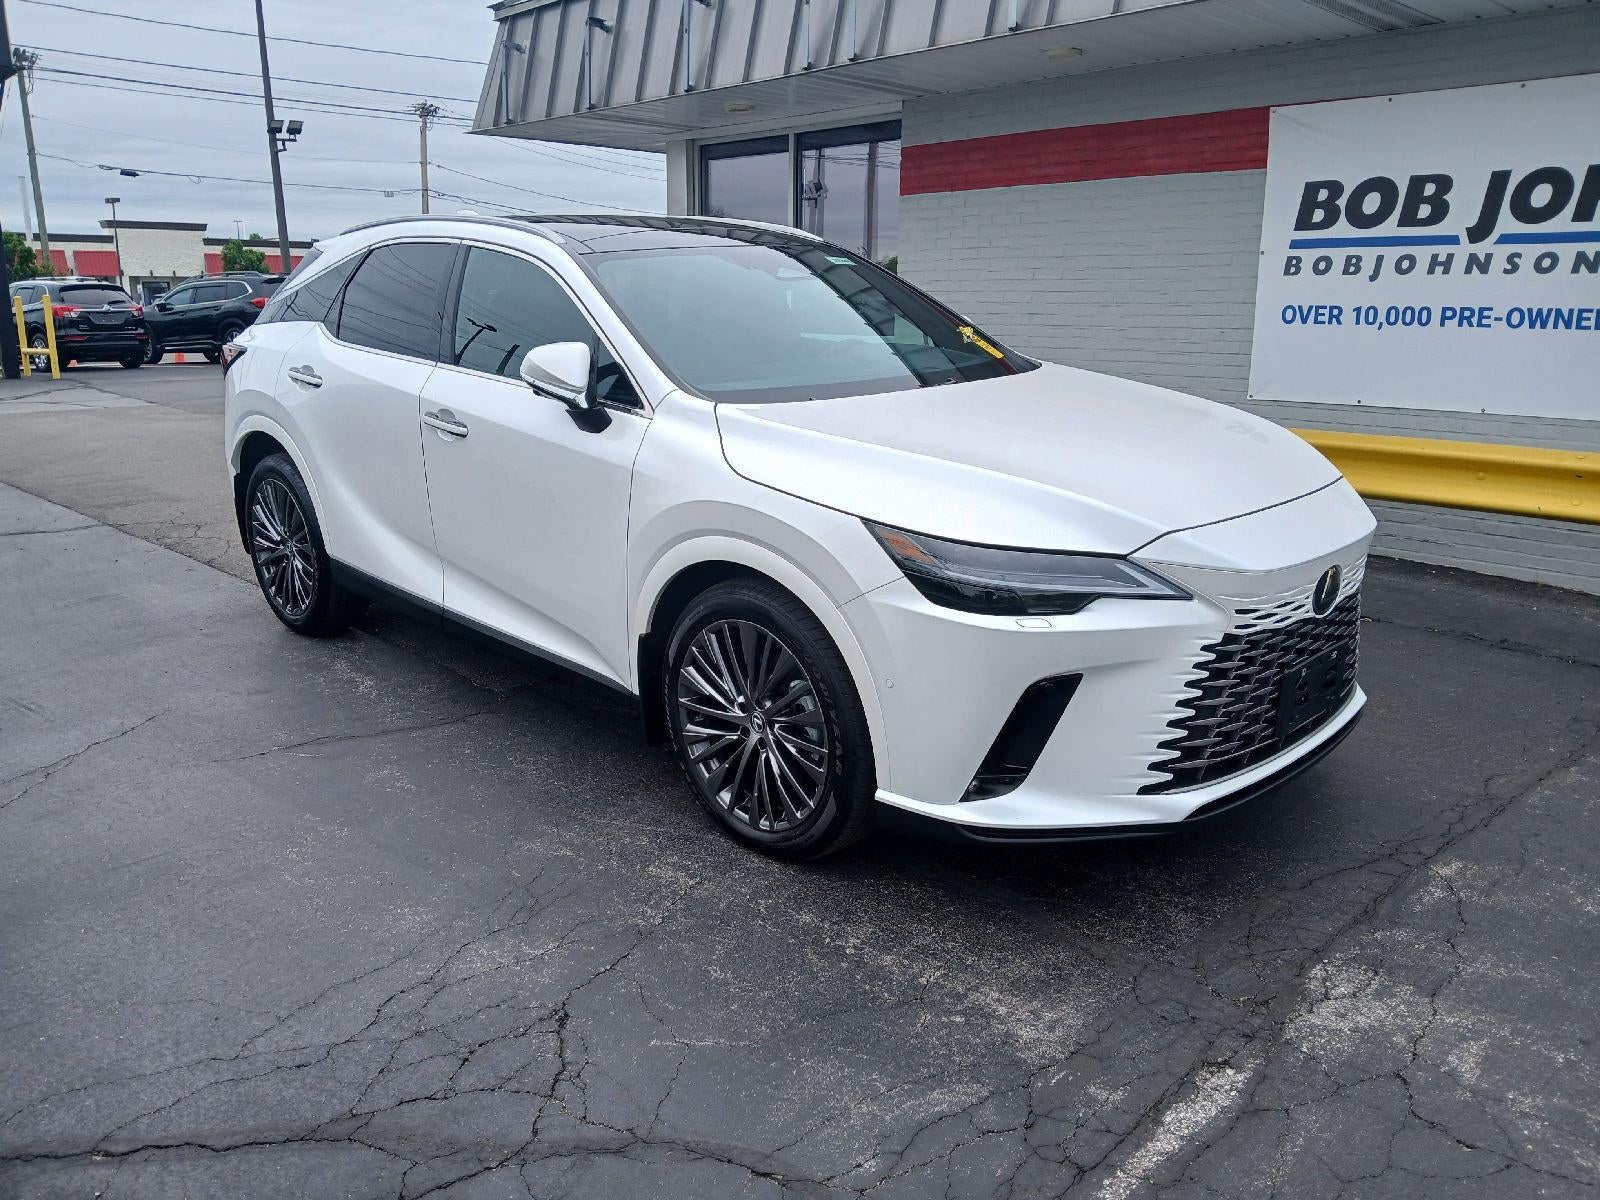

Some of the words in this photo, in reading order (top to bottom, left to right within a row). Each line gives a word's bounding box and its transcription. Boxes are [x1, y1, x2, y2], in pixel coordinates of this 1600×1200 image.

[1293, 173, 1454, 232] BOB
[1283, 250, 1600, 283] BOBJOHNSON
[1281, 304, 1344, 326] OVER
[1351, 305, 1432, 332] 10,000
[1439, 306, 1600, 331] PRE-OWNE
